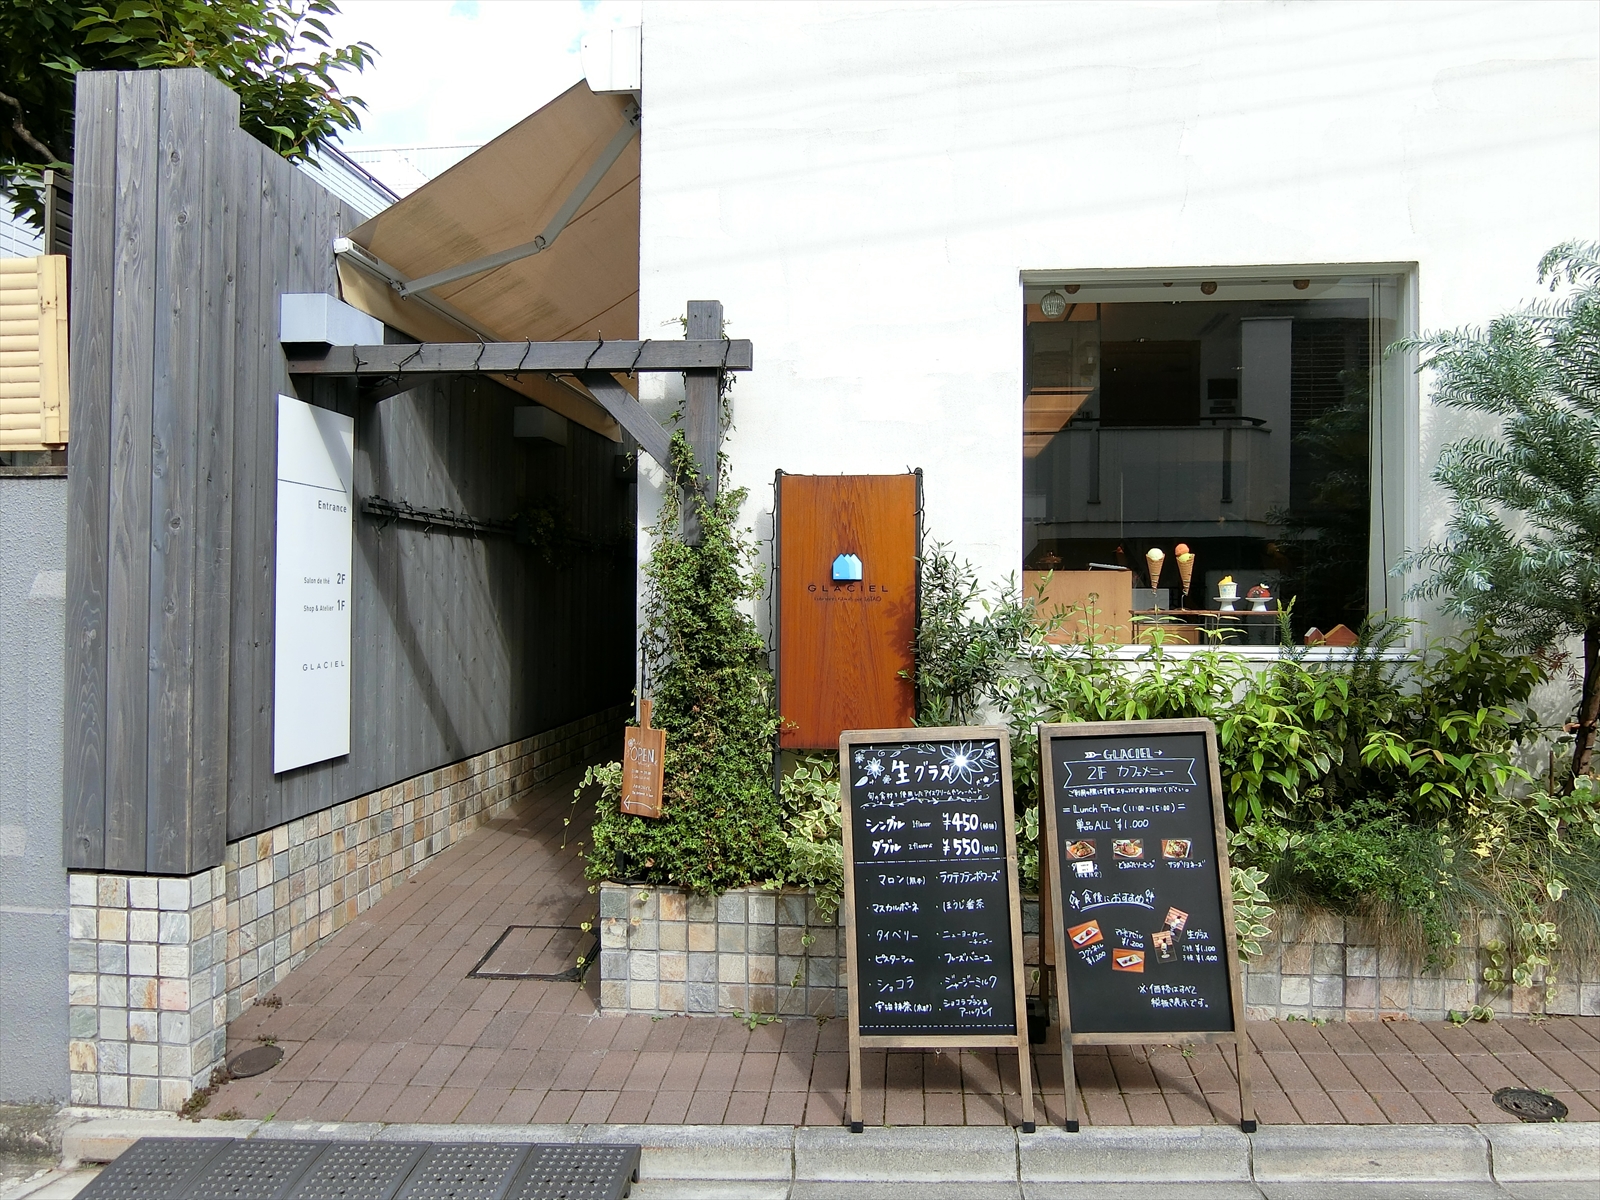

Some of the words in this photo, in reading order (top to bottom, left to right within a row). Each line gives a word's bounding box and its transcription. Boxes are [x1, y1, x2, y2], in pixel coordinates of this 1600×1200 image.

[317, 500, 347, 513] Entrance
[336, 572, 346, 585] 2F
[807, 584, 889, 593] GLACIEL
[303, 604, 315, 613] Shop
[336, 599, 346, 611] 1F
[302, 660, 345, 671] GLACIEL
[630, 746, 655, 763] OPEN
[1103, 747, 1153, 760] GLACIEL
[1116, 765, 1174, 778] カフェメニュー
[1073, 804, 1098, 814] Lunch
[1100, 803, 1120, 813] Time
[865, 815, 906, 833] シングル
[872, 838, 902, 856] ダブル
[872, 901, 920, 914] マスカルポーネ
[876, 929, 919, 941] タイベリー
[1186, 928, 1209, 940] 生グラス
[875, 953, 914, 964] ピスターシュ
[877, 975, 915, 992] ショコラ
[945, 974, 997, 989] ジャージーミルク
[958, 1006, 993, 1017] アールグレイ
